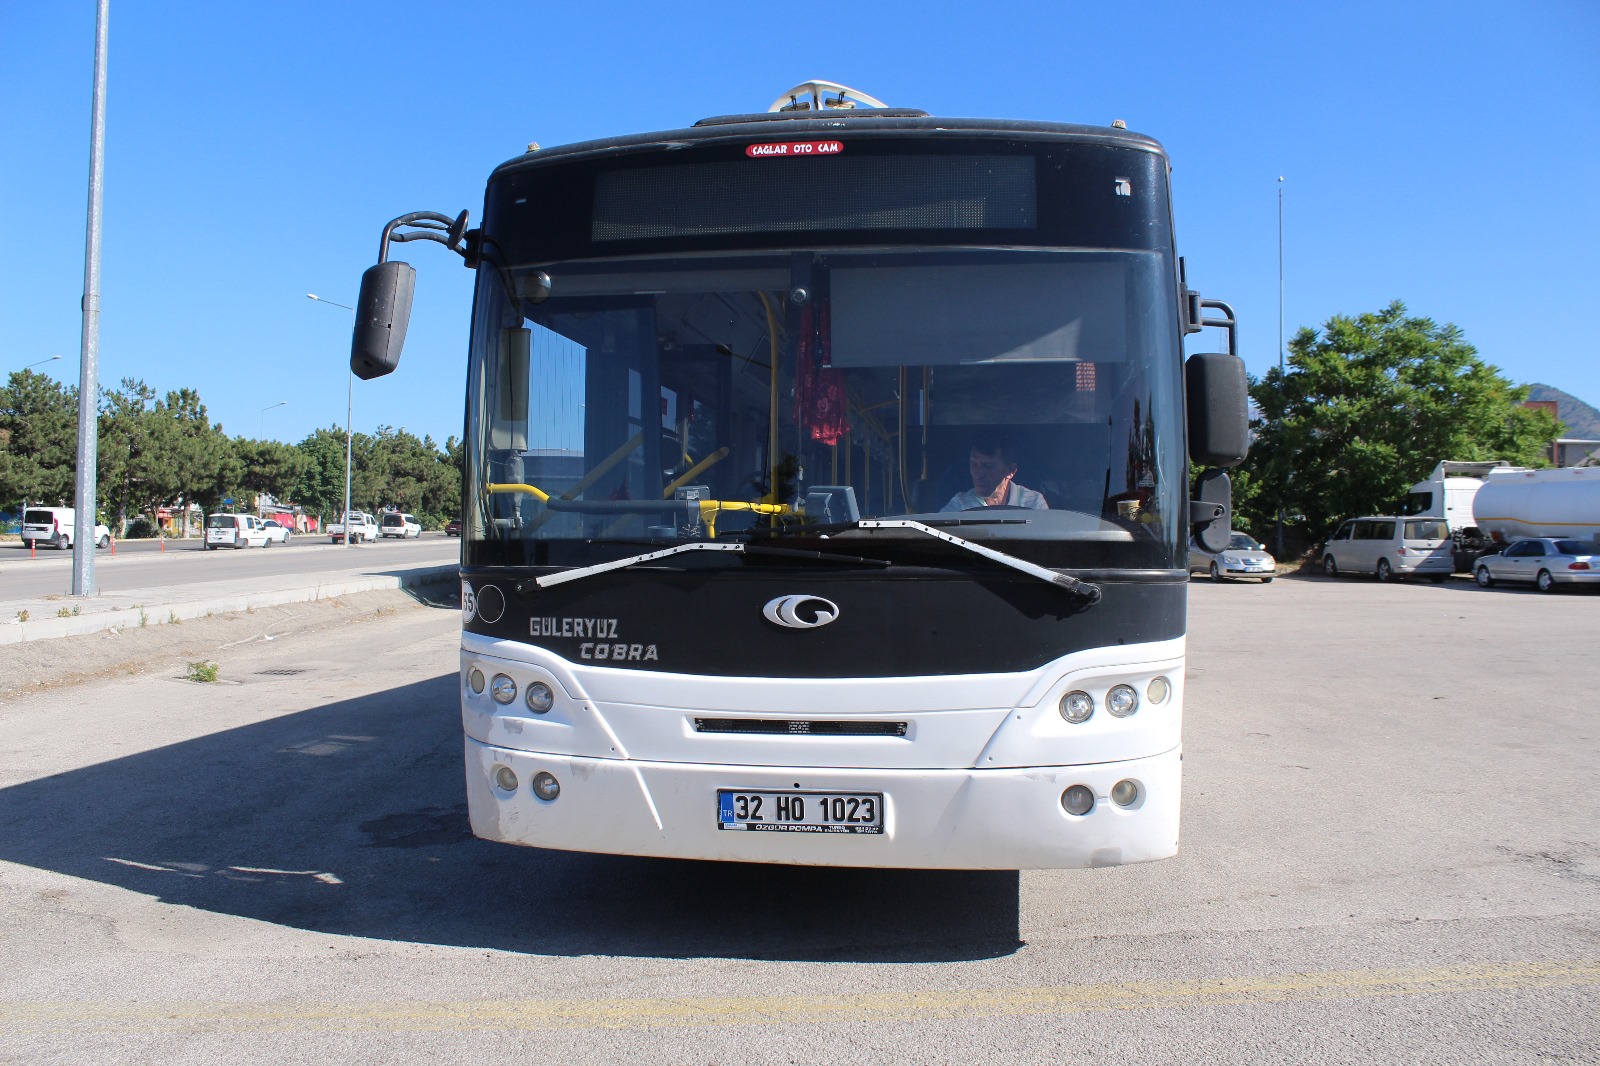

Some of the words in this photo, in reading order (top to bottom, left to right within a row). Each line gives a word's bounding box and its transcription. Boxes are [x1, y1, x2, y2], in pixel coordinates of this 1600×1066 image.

[793, 144, 812, 153] OTO
[818, 143, 838, 152] CAM
[579, 643, 659, 661] COBRA
[722, 809, 733, 818] TR
[735, 795, 764, 820] 32
[776, 796, 805, 821] HO
[820, 797, 875, 823] 1023
